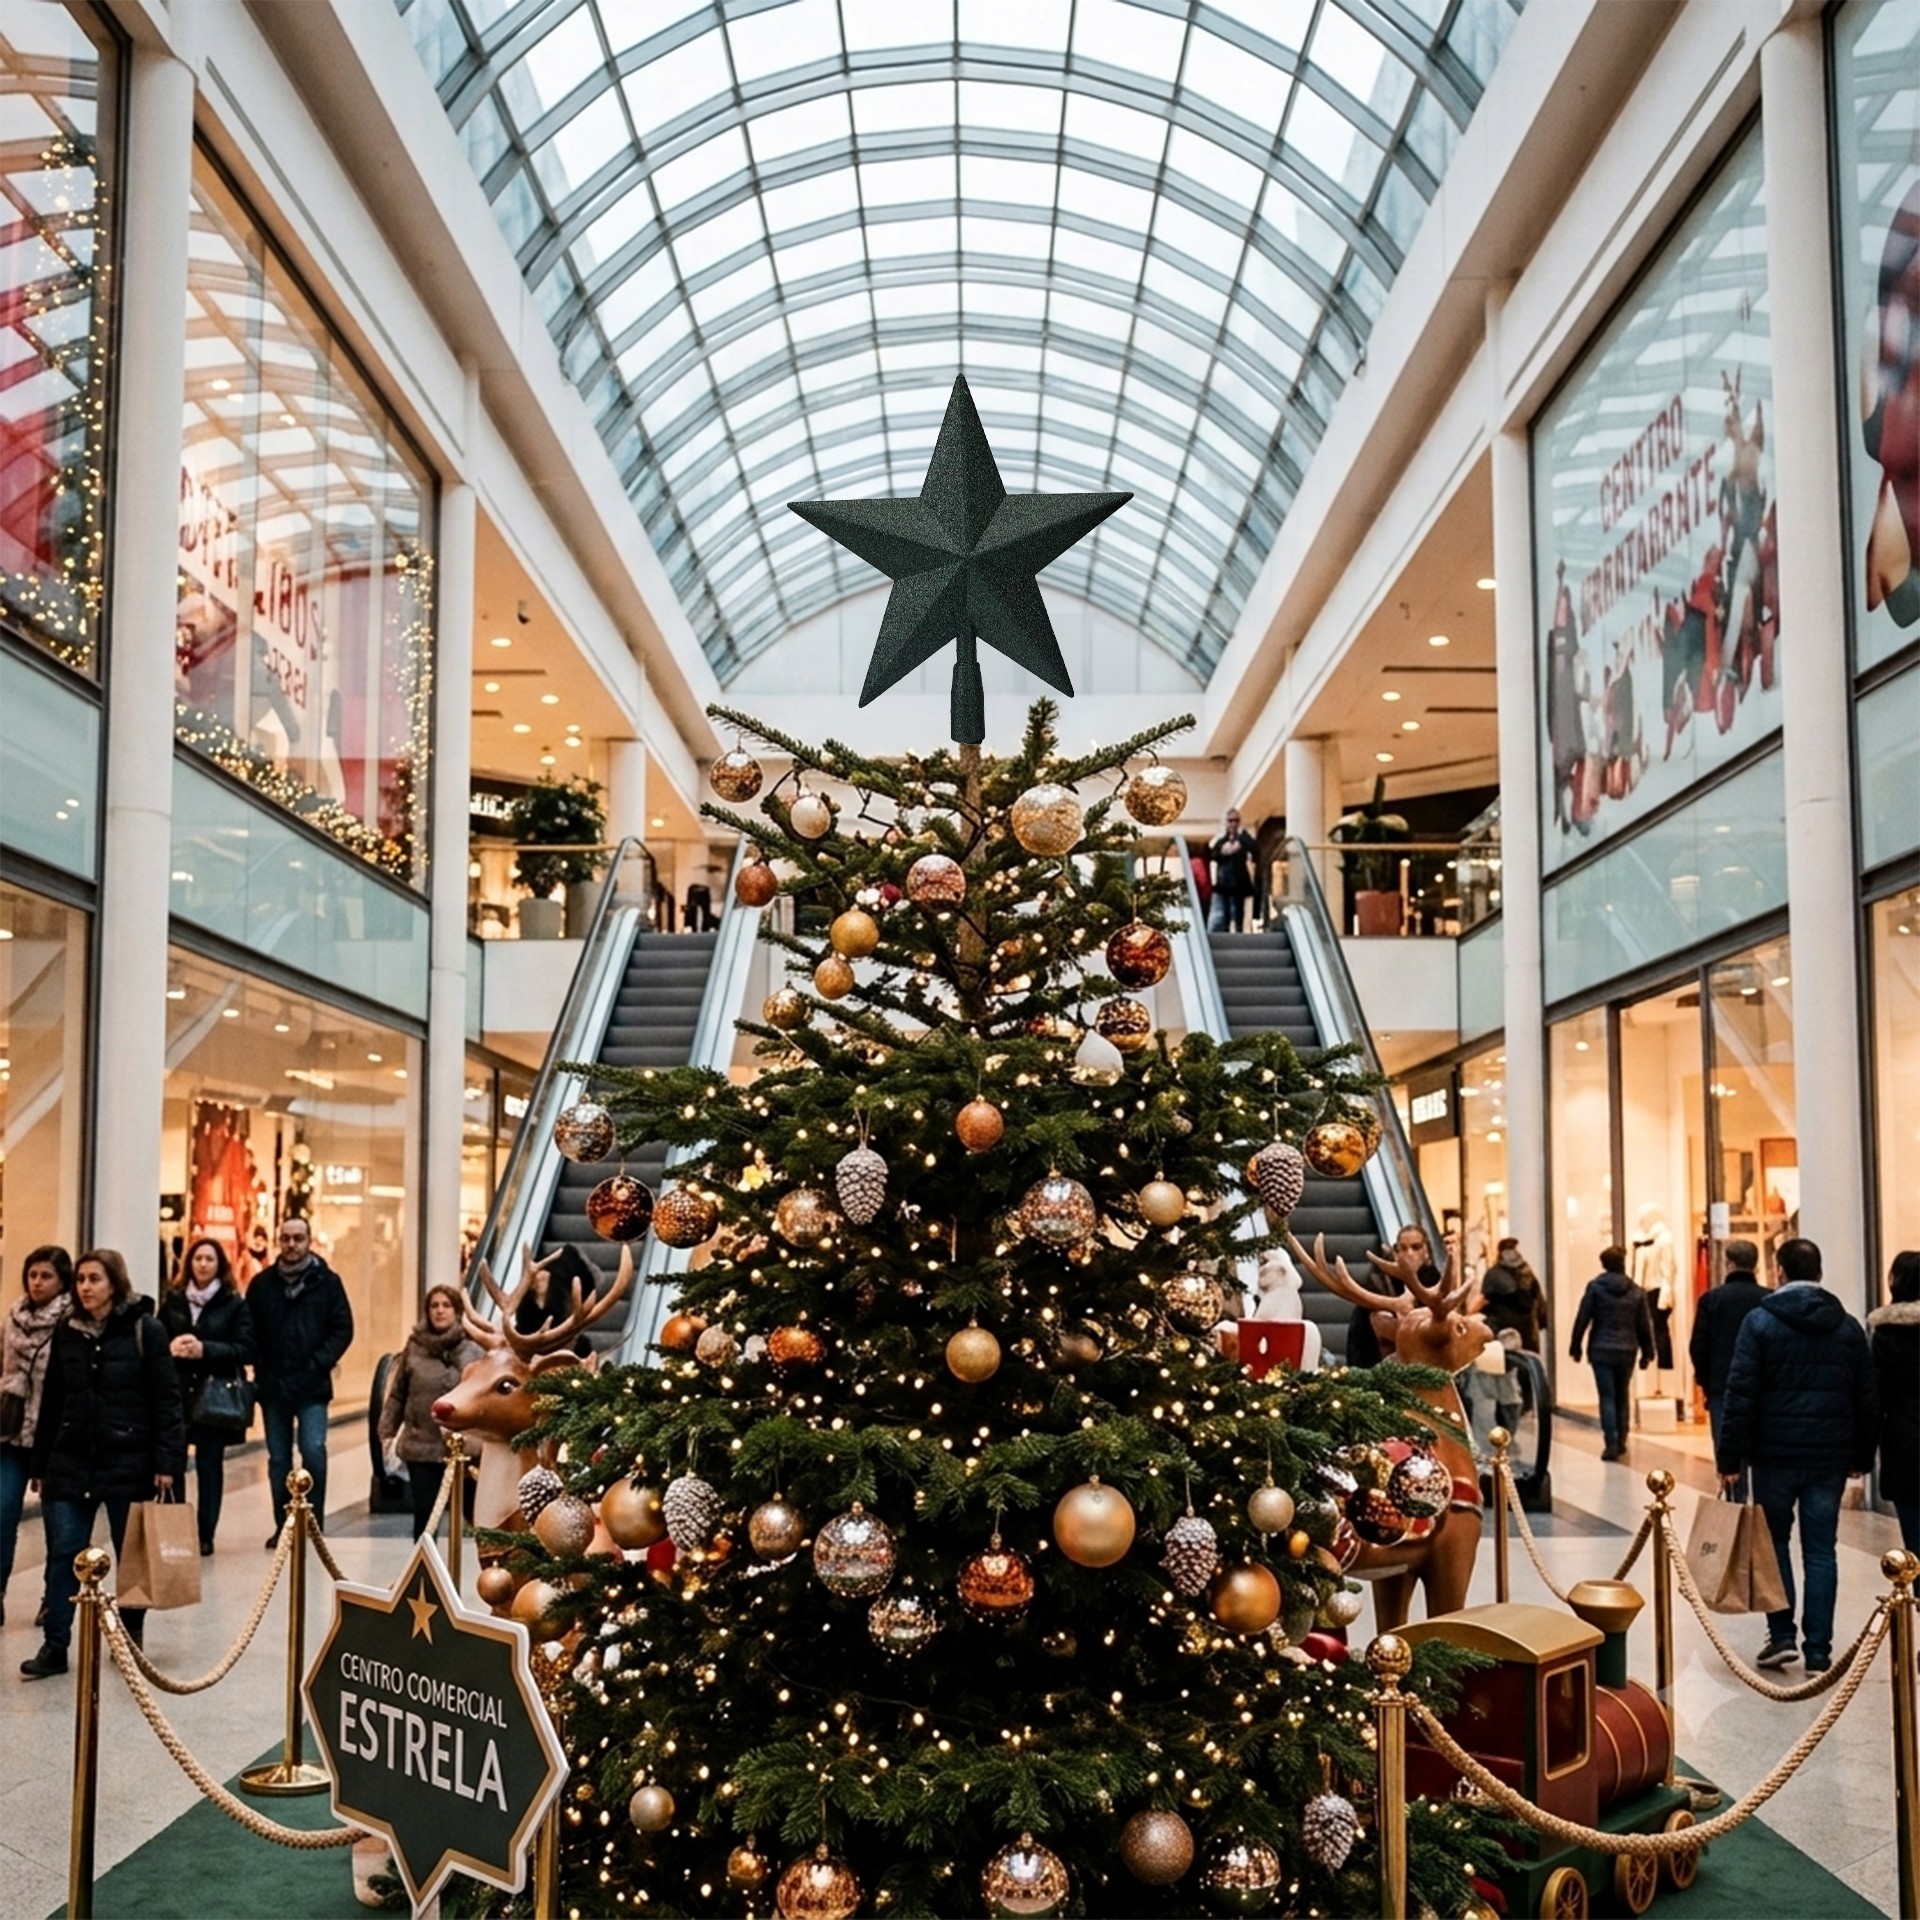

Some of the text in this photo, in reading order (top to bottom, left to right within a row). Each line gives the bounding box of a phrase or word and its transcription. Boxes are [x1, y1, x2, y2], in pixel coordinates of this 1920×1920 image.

[340, 1652, 507, 1729] CENTRO COMERCIAL
[340, 1690, 508, 1812] ESTRELA
